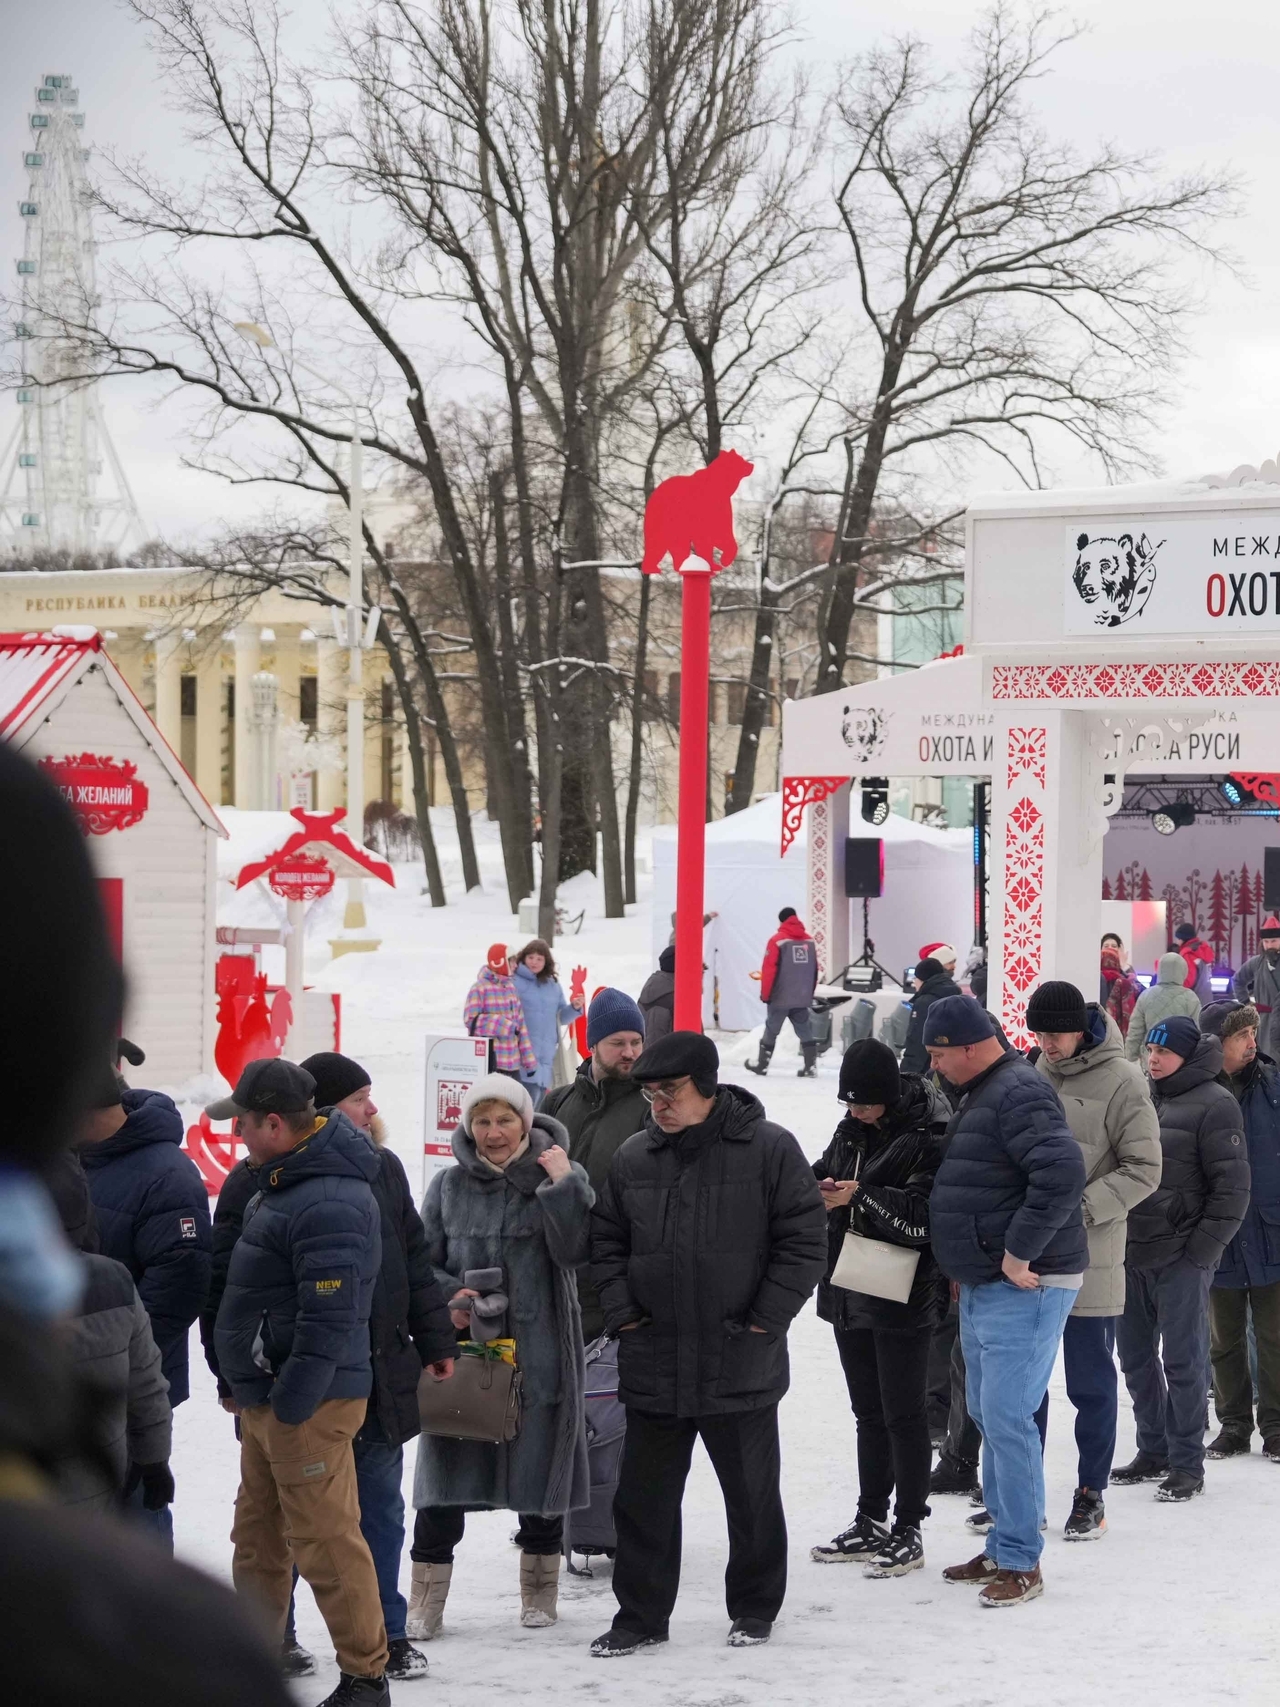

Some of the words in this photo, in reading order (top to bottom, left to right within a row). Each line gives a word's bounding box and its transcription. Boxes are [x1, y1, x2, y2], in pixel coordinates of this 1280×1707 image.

[26, 595, 126, 611] РЕСПУБЛИКА
[922, 713, 994, 728] МЕЖДУНА
[919, 736, 976, 762] ОХОТА
[984, 735, 993, 761] И
[1189, 733, 1240, 760] РУСИ
[77, 784, 132, 805] ЖЕЛАНИЙ
[862, 1193, 892, 1219] TWINSET
[316, 1279, 342, 1290] NEW
